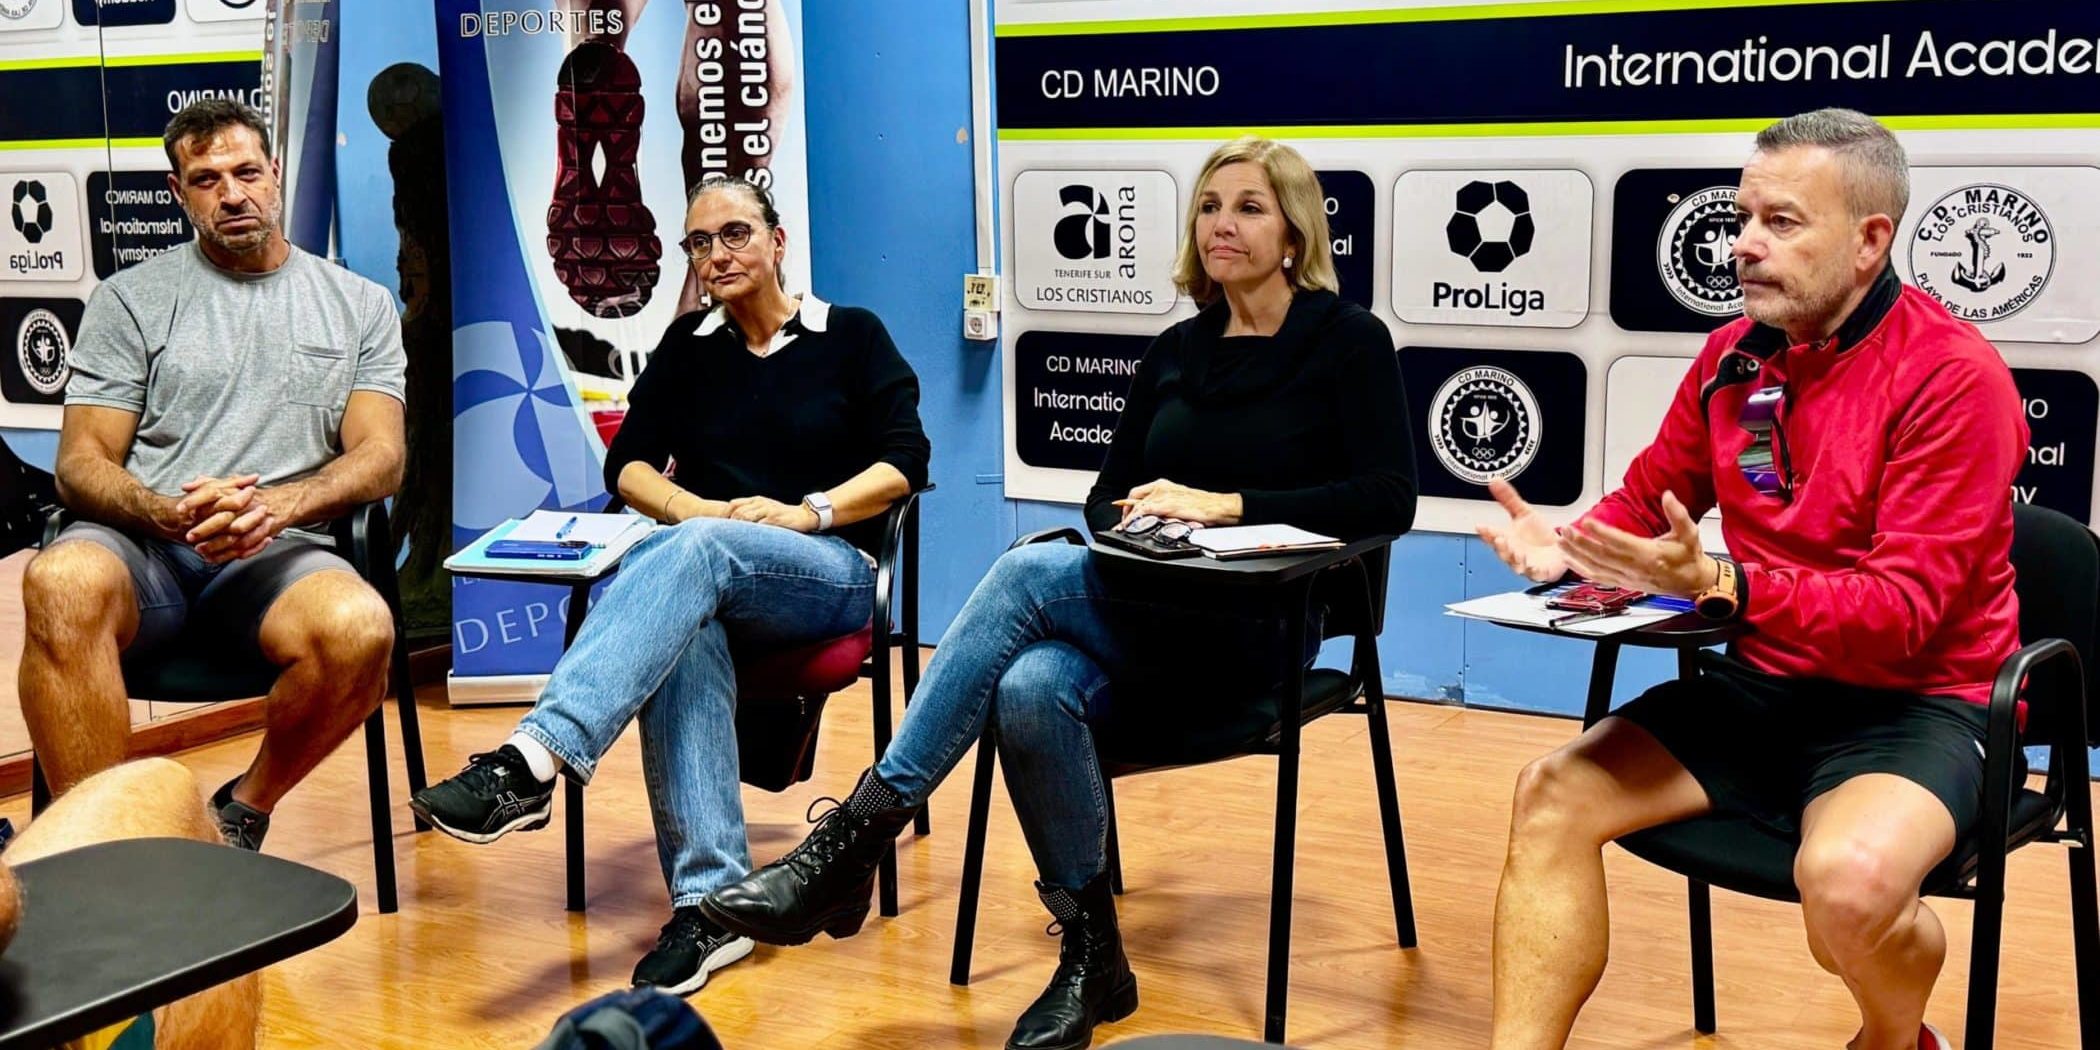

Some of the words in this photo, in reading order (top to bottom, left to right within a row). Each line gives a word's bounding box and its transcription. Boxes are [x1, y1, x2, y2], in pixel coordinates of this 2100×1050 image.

[460, 9, 624, 37] DEPORTES
[1564, 34, 1891, 89] International
[1905, 29, 2100, 78] Acade
[1041, 69, 1084, 99] CD
[1094, 65, 1221, 98] MARINO
[734, 118, 771, 156] el
[1692, 194, 1708, 207] CD
[1932, 216, 1956, 242] LOS
[1957, 203, 2034, 243] CRISTIANOS
[1965, 189, 2049, 244] MARINO
[1055, 269, 1092, 279] TENERIFE
[1094, 269, 1112, 279] SUR
[1036, 286, 1063, 301] LOS
[1066, 287, 1153, 305] CRISTIANOS
[1433, 282, 1545, 316] ProLiga
[1675, 287, 1724, 311] International
[1944, 301, 1961, 315] DE
[1963, 307, 1988, 319] LAS
[1991, 274, 2044, 317] AMÉRICAS
[1046, 355, 1071, 372] CD
[1458, 372, 1472, 384] CD
[1474, 370, 1515, 387] MARINO
